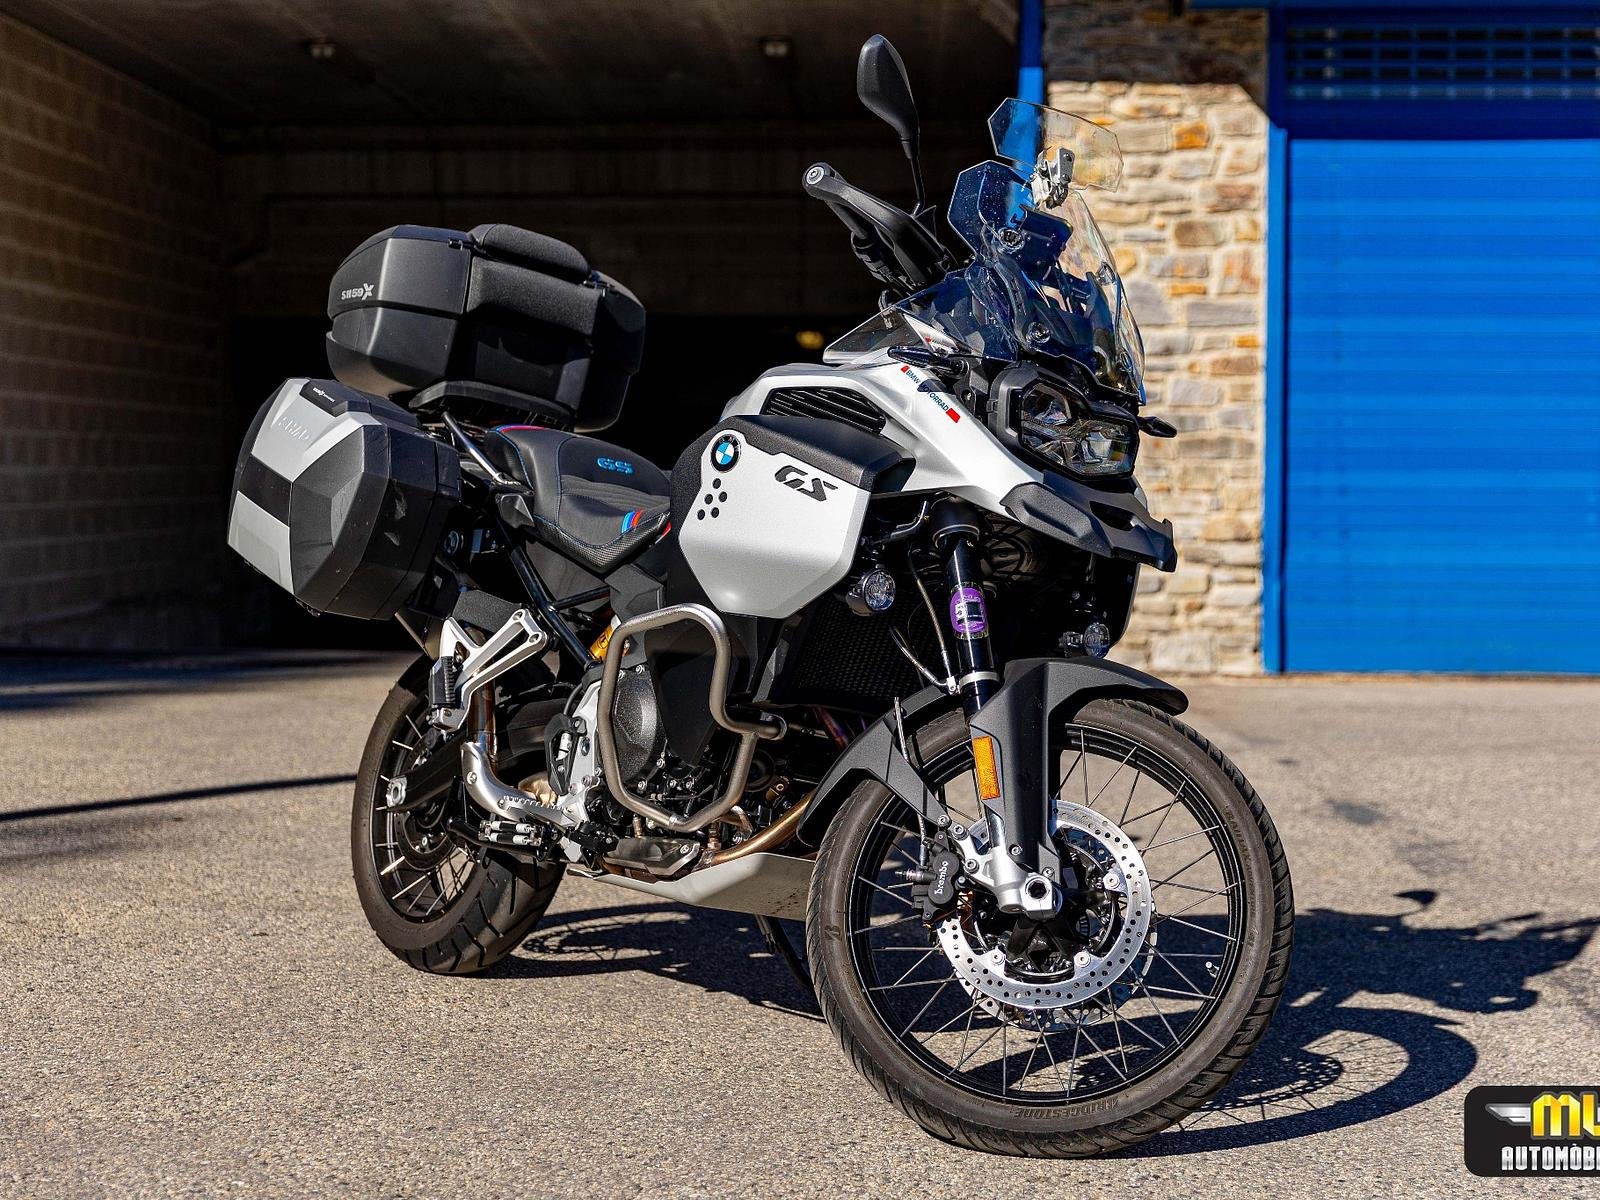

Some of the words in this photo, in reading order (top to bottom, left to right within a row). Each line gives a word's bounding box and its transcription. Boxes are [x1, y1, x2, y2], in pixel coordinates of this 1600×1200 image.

[905, 369, 922, 384] BMW
[597, 457, 633, 474] GS
[774, 464, 839, 502] GS
[933, 860, 949, 895] brembo
